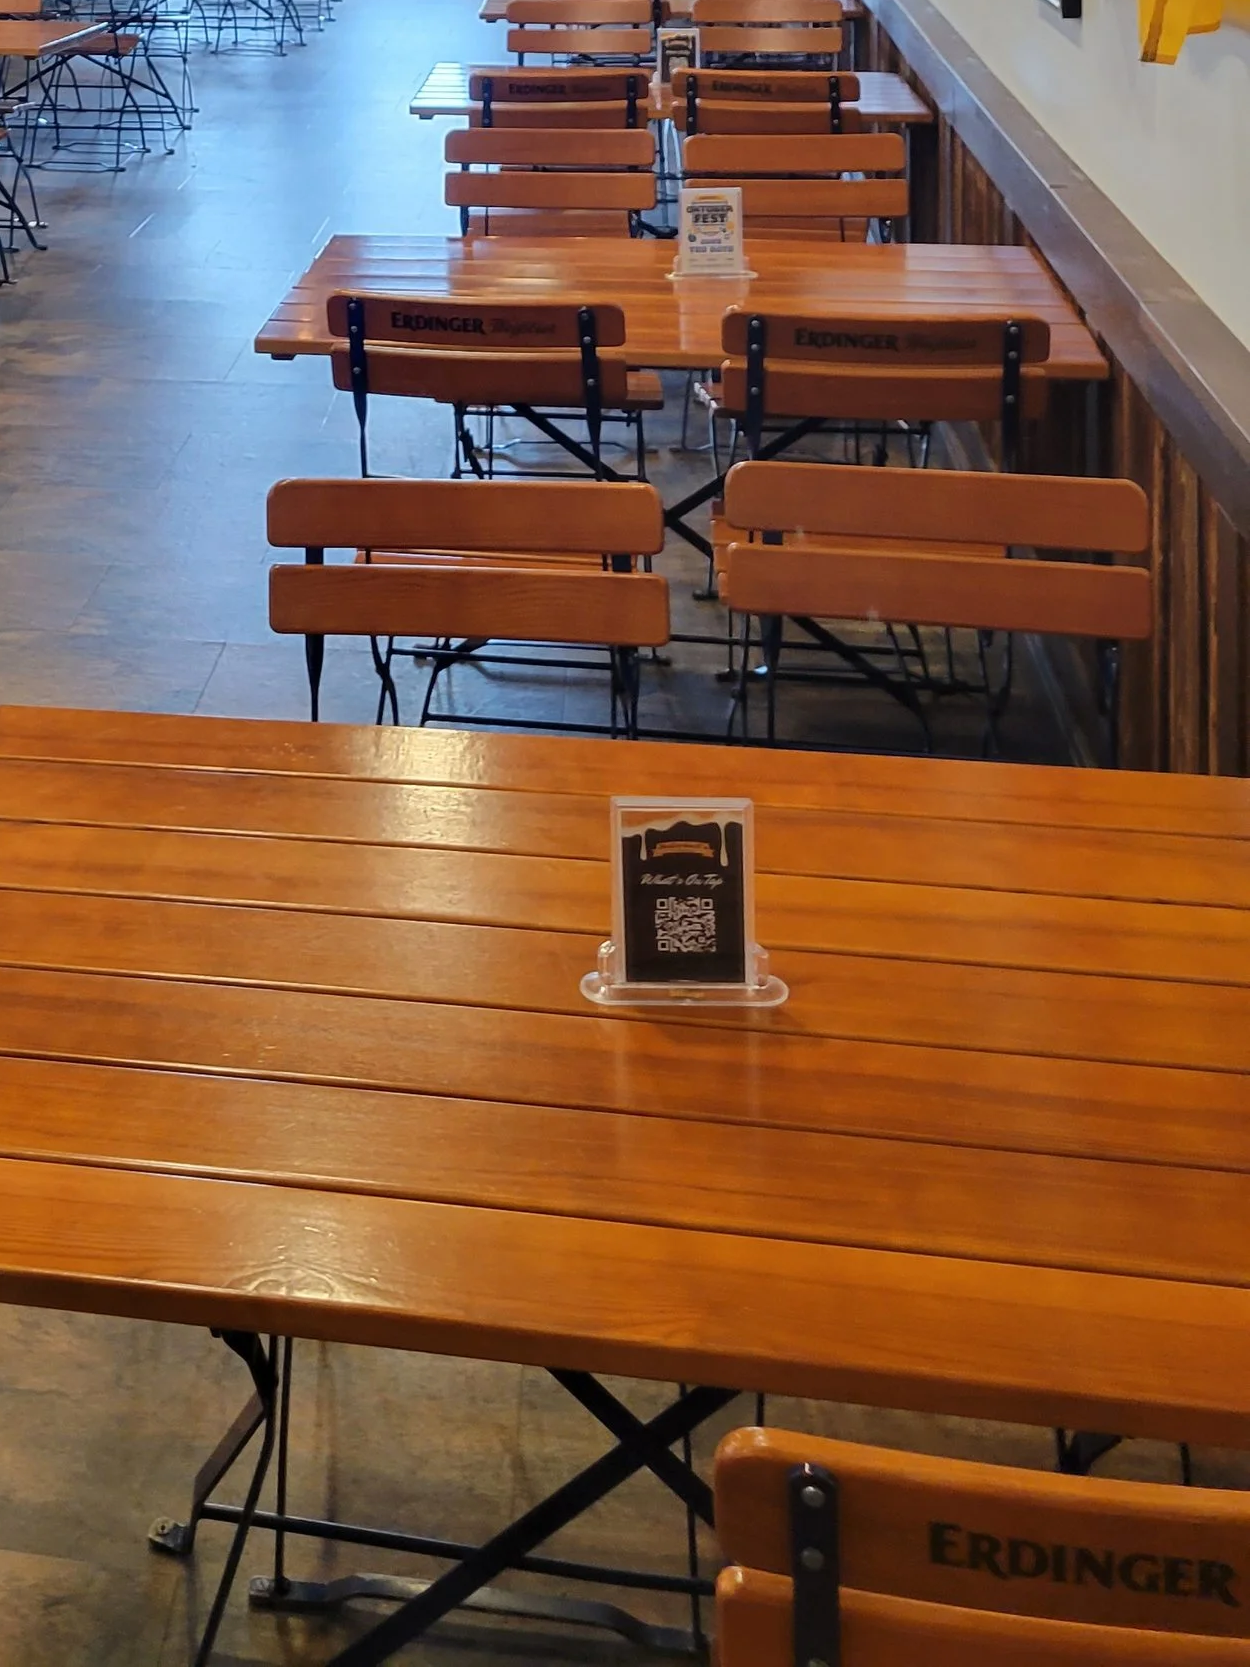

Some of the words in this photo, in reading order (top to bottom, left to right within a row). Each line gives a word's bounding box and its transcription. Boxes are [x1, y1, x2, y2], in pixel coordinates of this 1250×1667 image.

[693, 213, 727, 224] FEST
[391, 312, 488, 335] ERDINGER
[794, 327, 899, 352] ERDINGER
[685, 873, 703, 886] On
[703, 873, 724, 890] Tap
[928, 1520, 1241, 1608] ERDINGER
